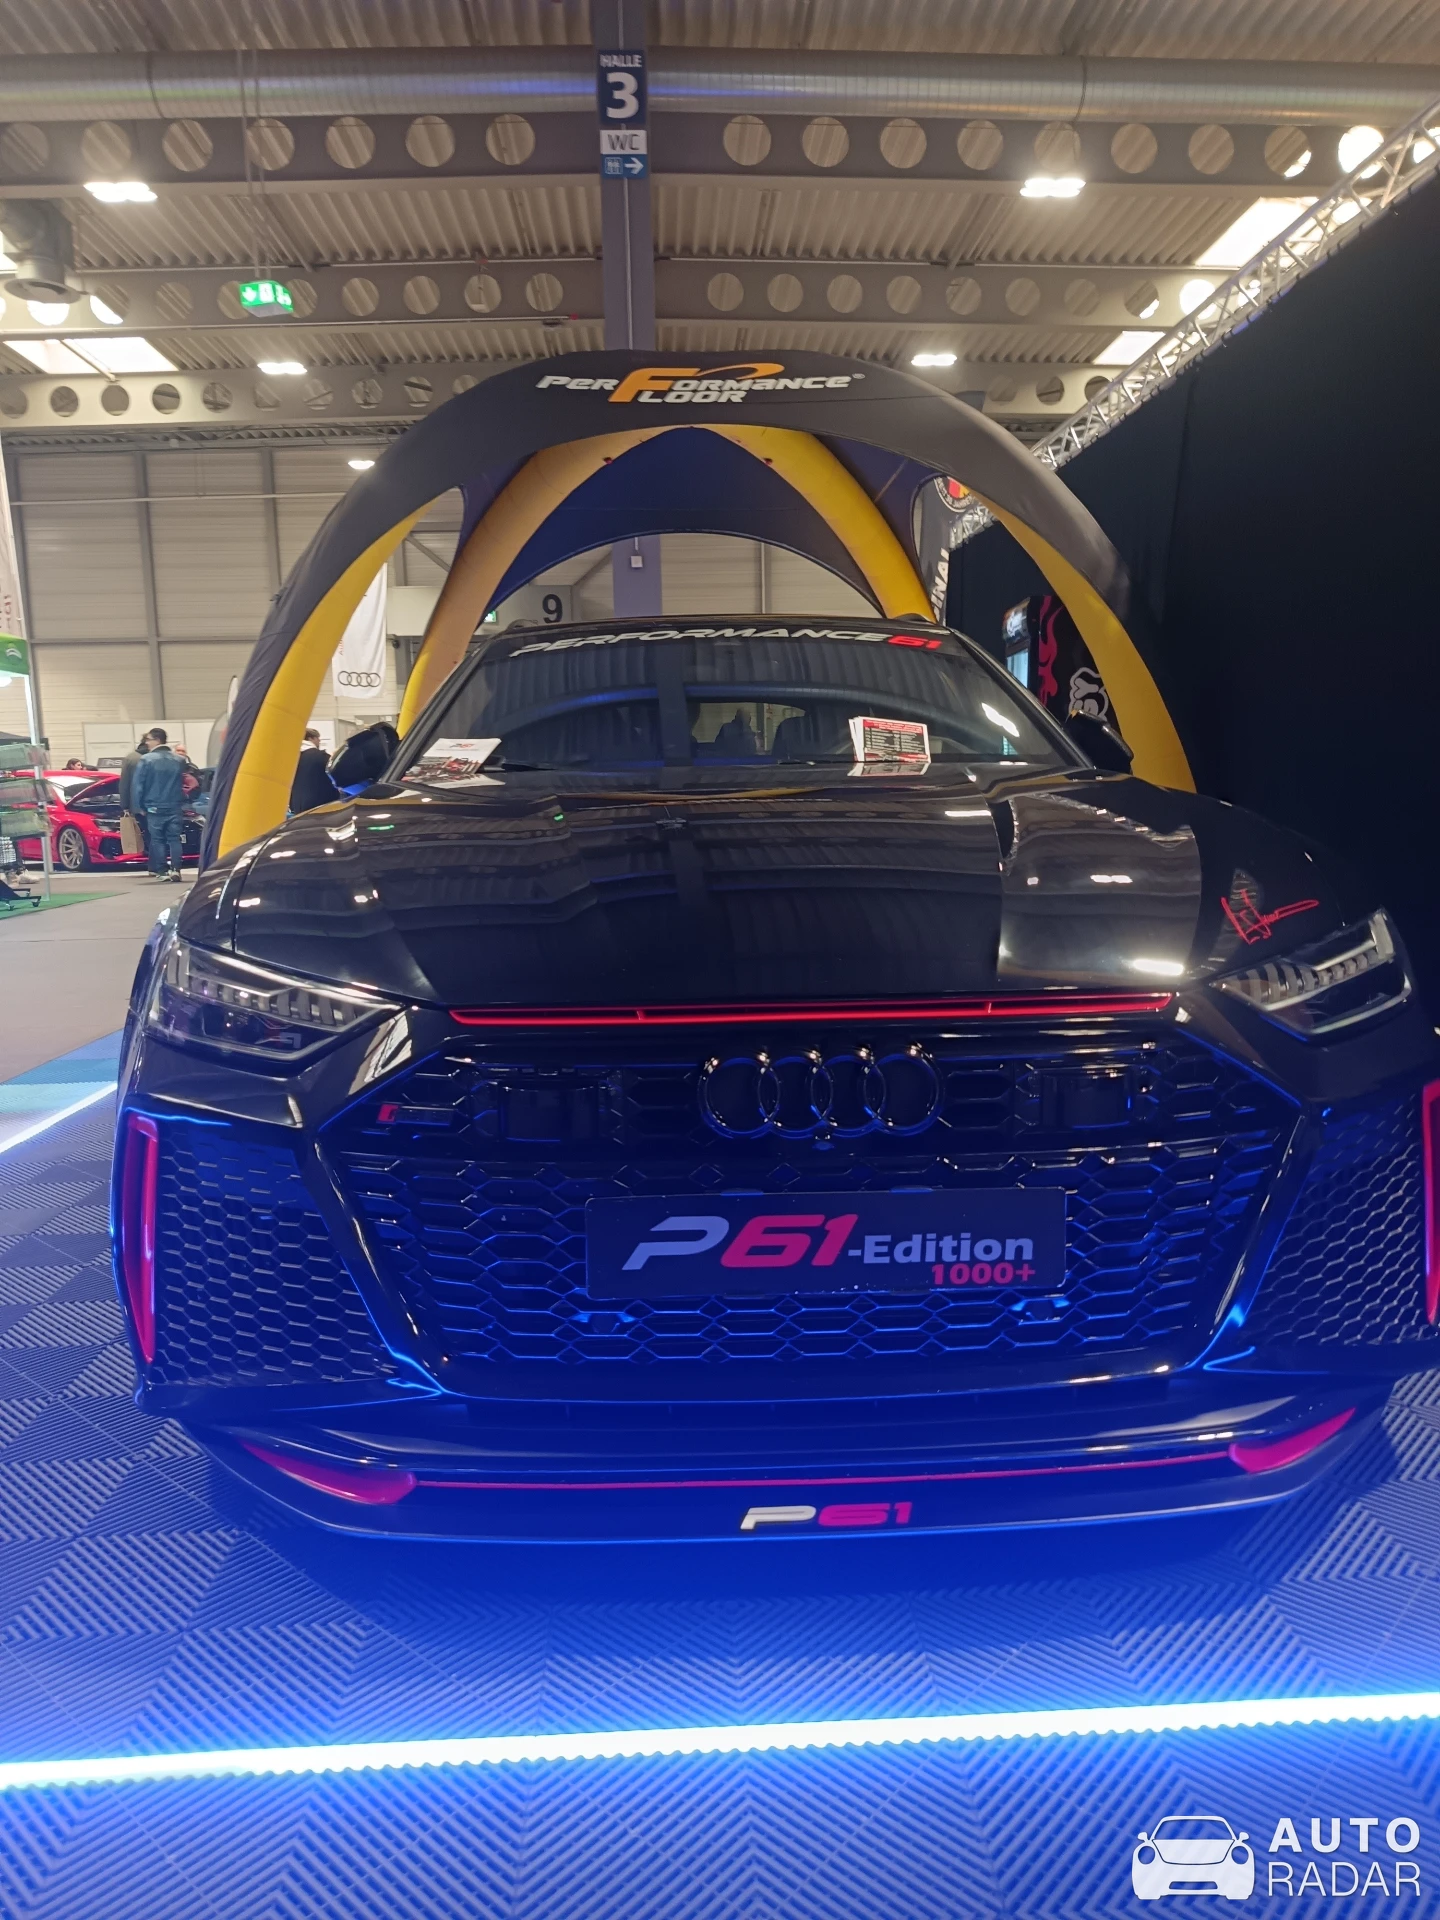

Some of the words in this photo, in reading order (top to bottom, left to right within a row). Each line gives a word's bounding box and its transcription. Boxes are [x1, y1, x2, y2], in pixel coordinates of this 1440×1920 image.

[600, 54, 642, 67] HALLE
[606, 72, 639, 118] 3
[607, 134, 640, 150] WC
[542, 594, 563, 623] 9
[931, 1263, 1036, 1285] 1000+
[740, 1502, 912, 1530] P61
